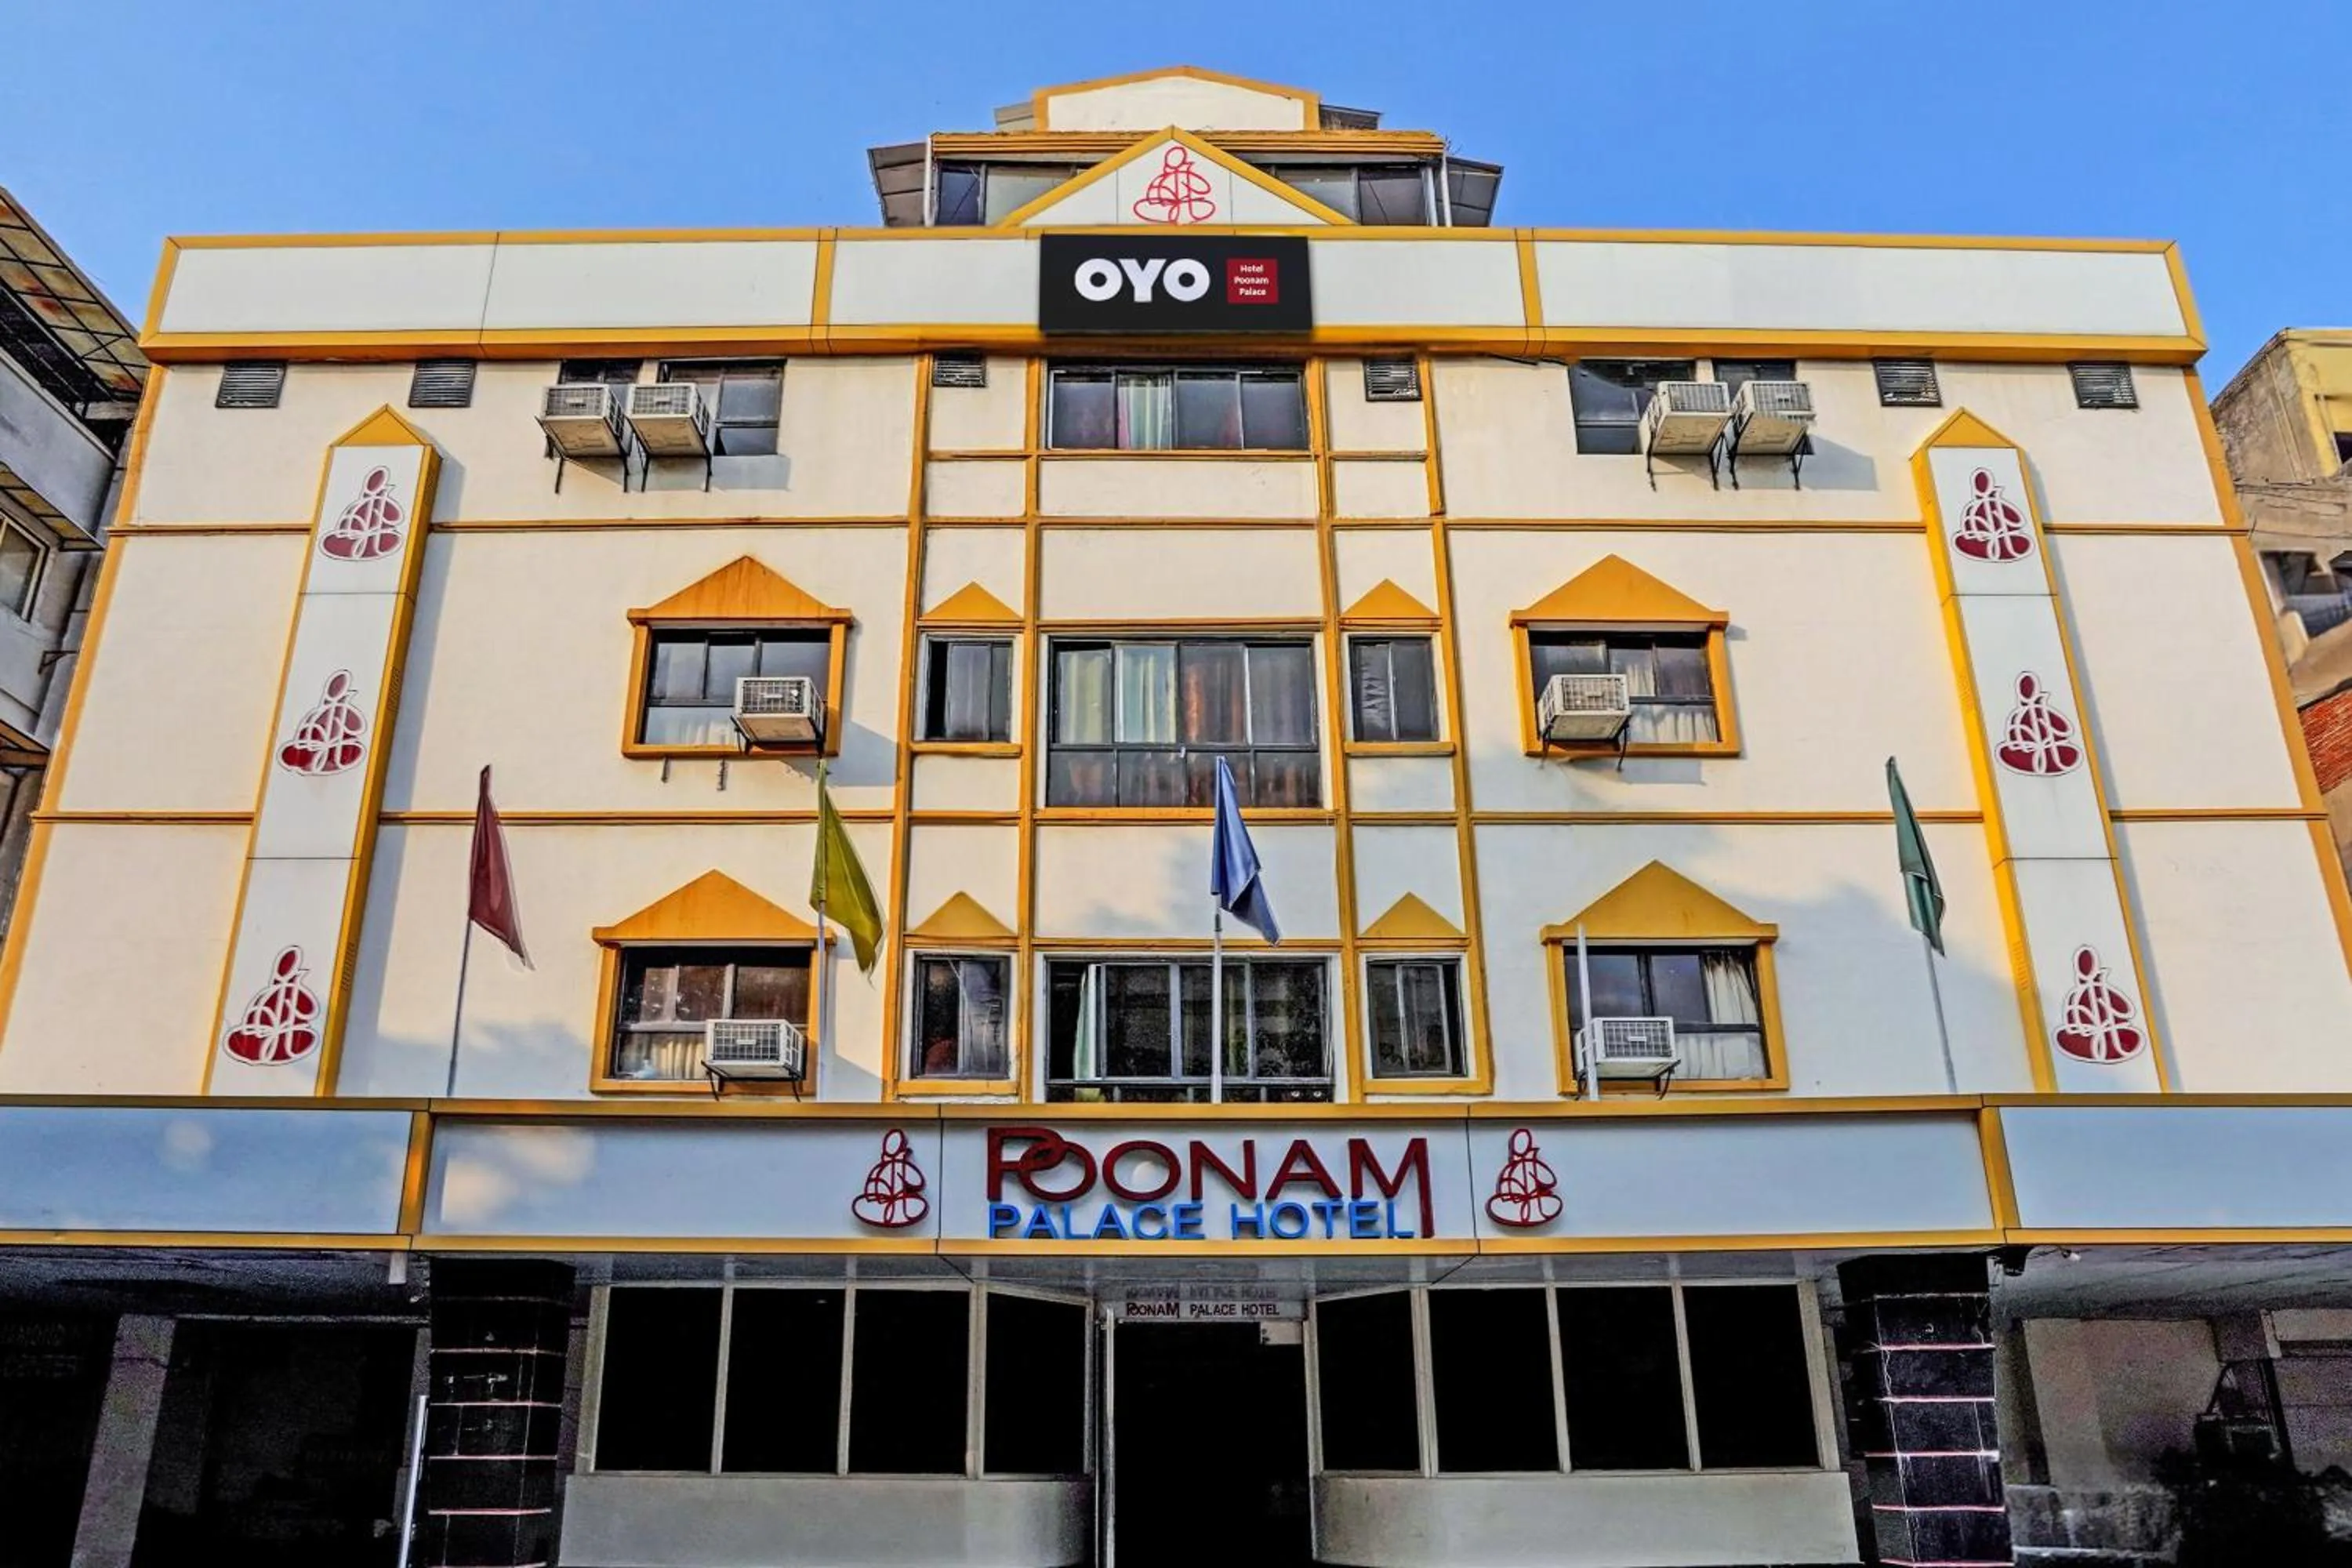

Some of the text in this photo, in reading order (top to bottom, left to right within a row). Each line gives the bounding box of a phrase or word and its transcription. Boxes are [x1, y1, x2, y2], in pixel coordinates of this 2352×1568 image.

[1240, 264, 1264, 273] Hotel
[1074, 258, 1210, 303] OYO
[1234, 276, 1269, 285] Poonam
[1240, 287, 1266, 296] Palace
[987, 1127, 1434, 1238] POONAM
[989, 1200, 1414, 1239] PALACE HOTEL
[1126, 1302, 1279, 1318] POONAM PALACE HOTEL
